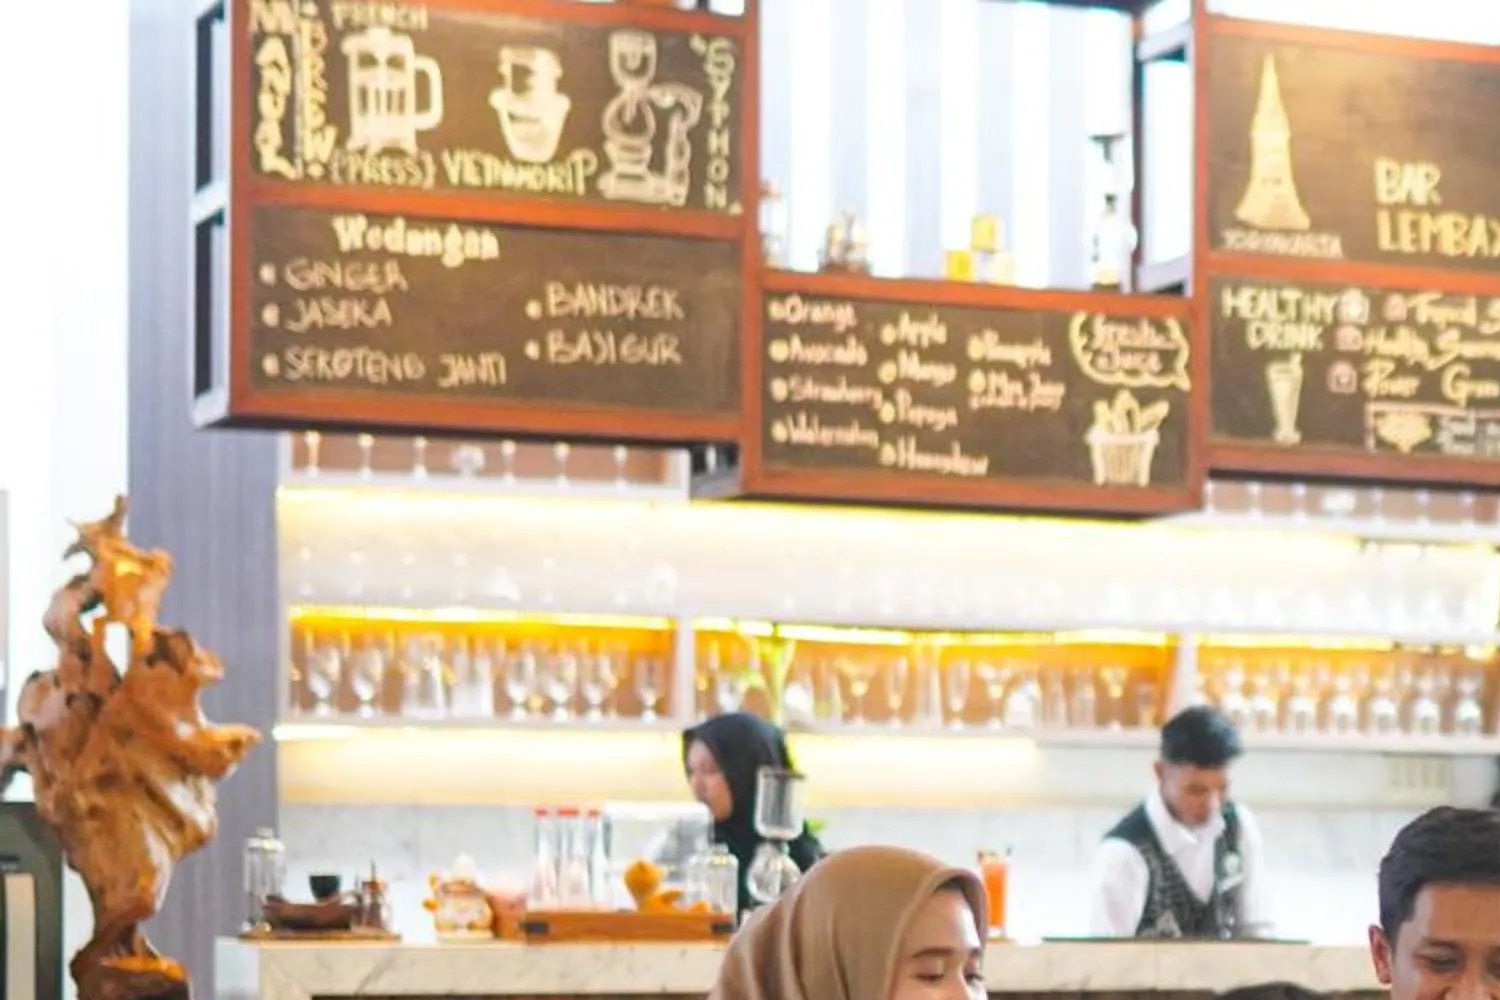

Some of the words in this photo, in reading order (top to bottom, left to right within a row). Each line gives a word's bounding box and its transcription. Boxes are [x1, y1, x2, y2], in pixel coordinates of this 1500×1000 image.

[1374, 156, 1442, 206] BAR
[1221, 285, 1339, 324] HEALTHY
[1246, 320, 1325, 351] DRINK
